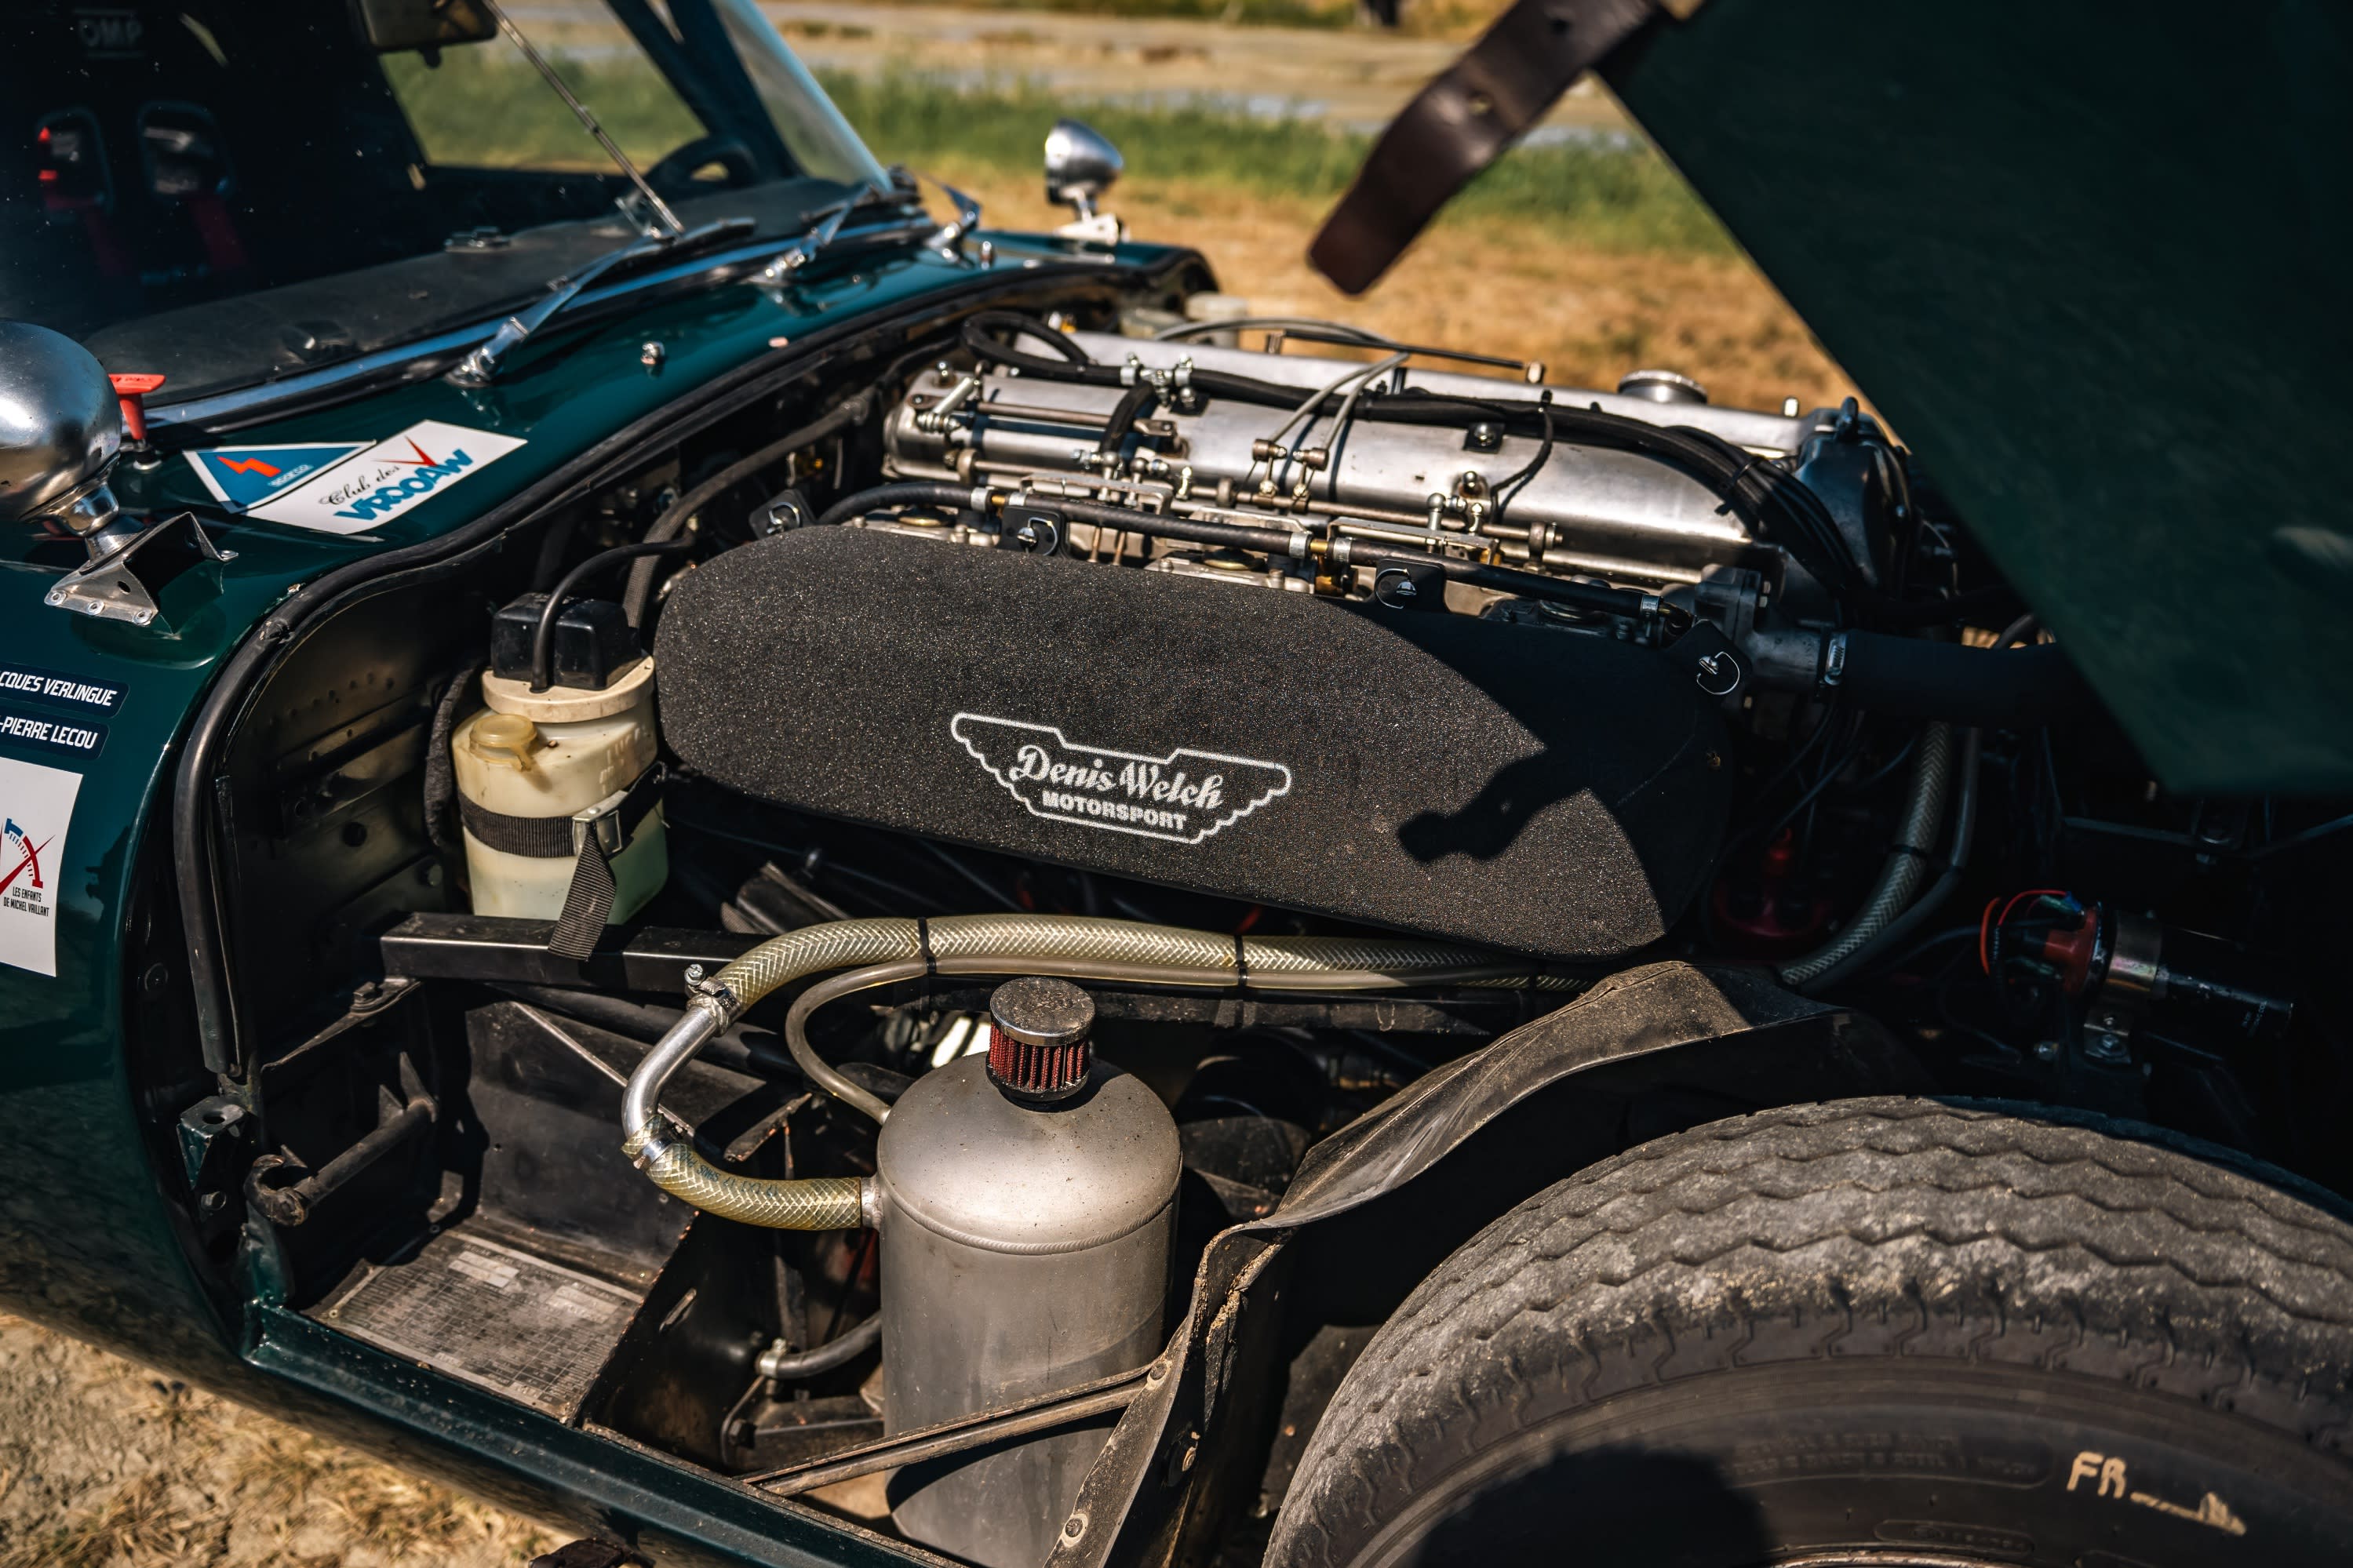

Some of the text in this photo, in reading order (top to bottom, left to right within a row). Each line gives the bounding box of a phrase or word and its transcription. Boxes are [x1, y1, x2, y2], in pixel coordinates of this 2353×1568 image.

[318, 475, 370, 505] Club
[0, 671, 118, 706] CQUES VERLINGUE
[0, 715, 98, 749] -PIERRE LECOU
[1008, 744, 1224, 809] Denis Welch
[1042, 790, 1186, 830] MOTORSPORT
[3, 897, 49, 917] DE MICHEL VAILLANT
[21, 888, 42, 903] ENFANTS
[2066, 1451, 2126, 1498] FR
